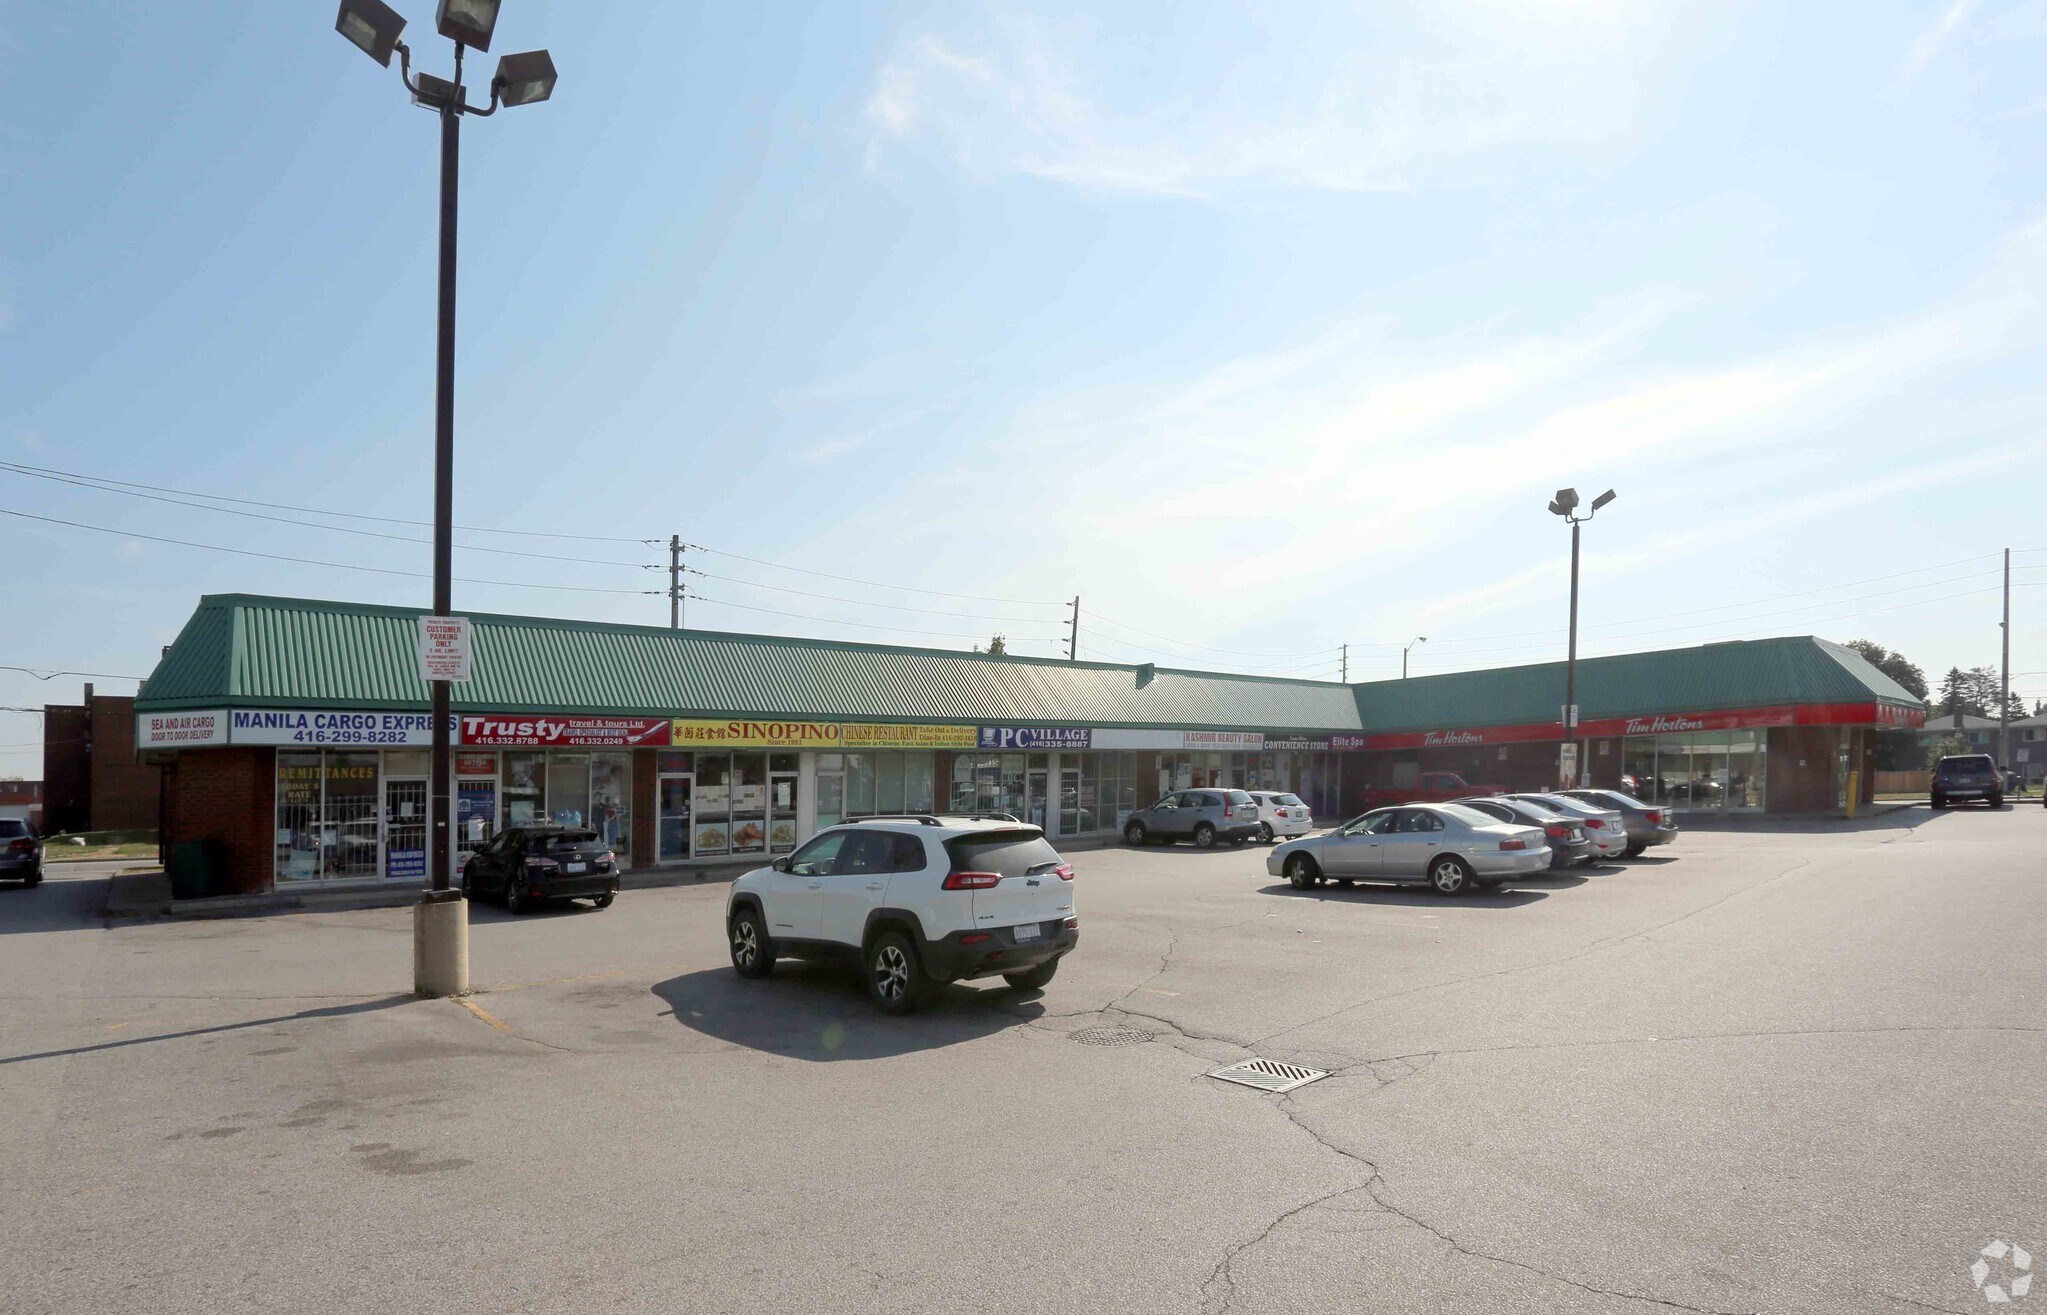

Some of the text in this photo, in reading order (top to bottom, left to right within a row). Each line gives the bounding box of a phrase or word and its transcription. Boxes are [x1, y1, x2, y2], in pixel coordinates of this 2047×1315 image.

[426, 625, 461, 633] CUSTOMER
[151, 716, 215, 730] SEA AND AIR CARGO
[234, 712, 457, 730] MANILA CARGO EXPRES
[629, 720, 646, 728] Ltd.
[1626, 716, 1704, 734] Tim Hortons
[463, 717, 566, 740] Trusty
[727, 721, 839, 739] SINOPINO
[841, 725, 918, 740] CHINESE RESTAURANT
[951, 727, 976, 735] Delivery
[1030, 728, 1088, 740] VILLAGE
[151, 730, 214, 741] DOOR TO DOOR DELIVERY
[293, 730, 407, 742] 416-299-8282
[999, 727, 1029, 748] PC
[1185, 732, 1263, 743] KASHMIR BEAUTY SALON
[1332, 736, 1364, 747] Elite Spa
[1423, 730, 1483, 746] Tim Hortons
[1264, 740, 1309, 750] CONVENIENCE
[1309, 741, 1329, 750] STORE
[279, 767, 374, 779] REMITTANCES
